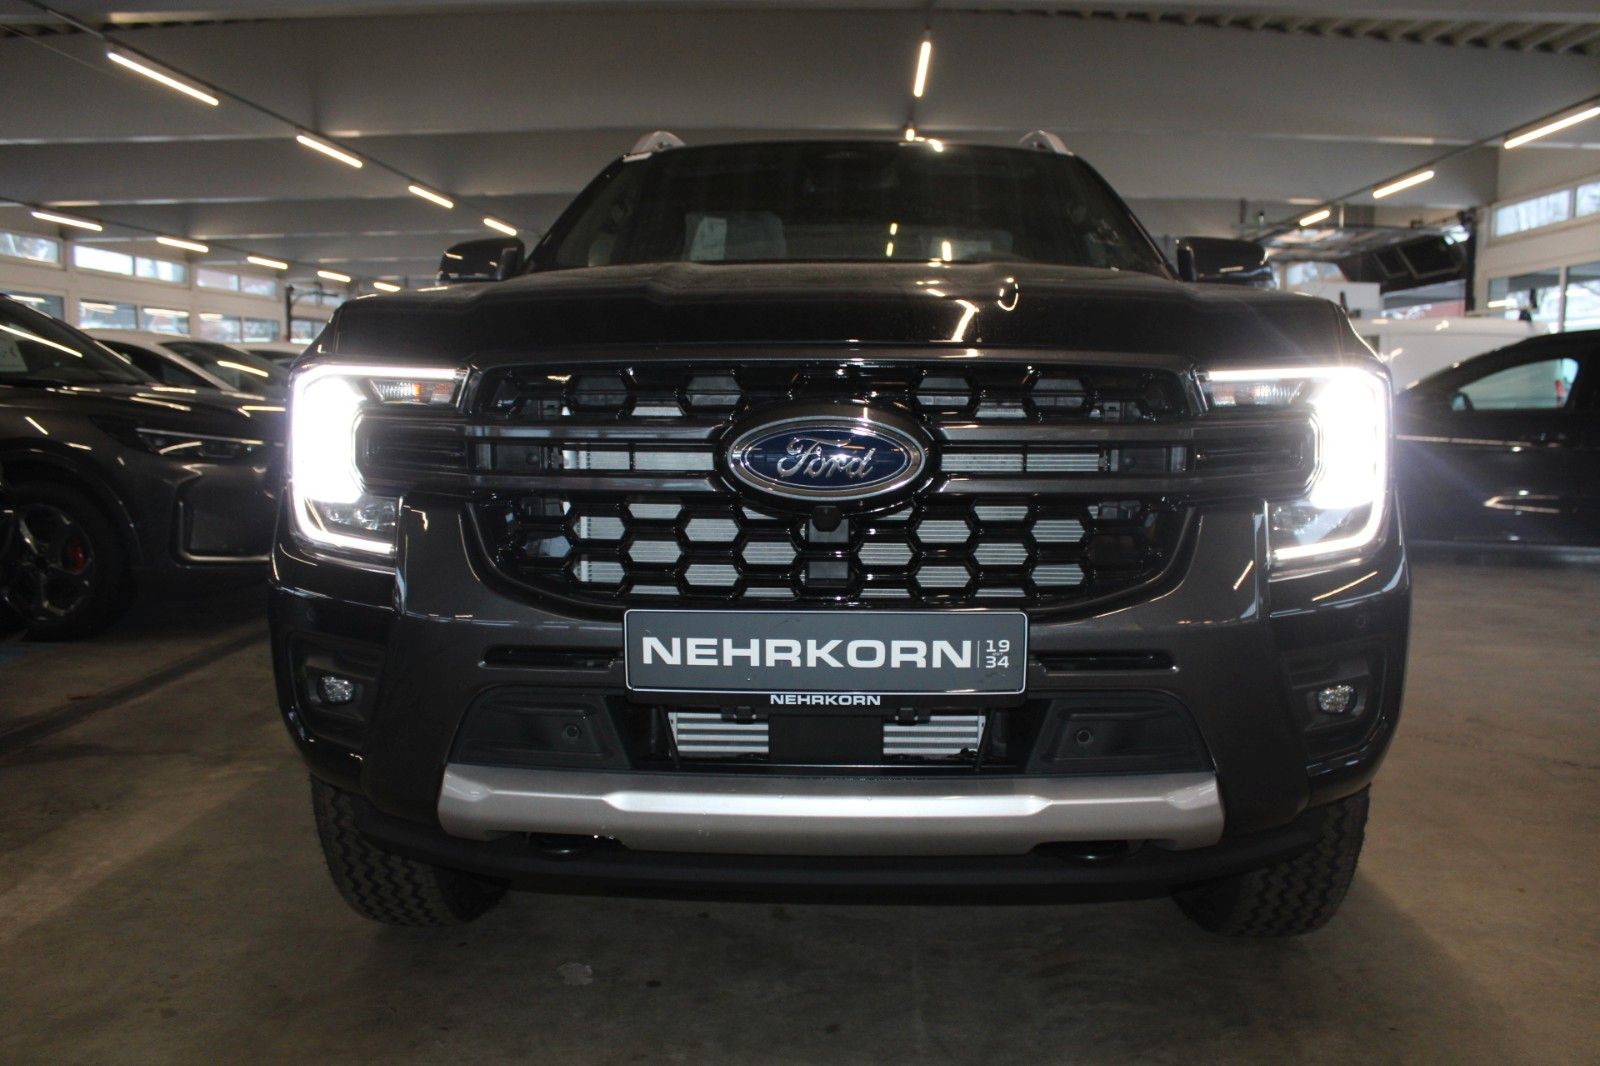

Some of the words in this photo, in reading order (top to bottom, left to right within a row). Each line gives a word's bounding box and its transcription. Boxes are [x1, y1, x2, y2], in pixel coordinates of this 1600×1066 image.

[776, 437, 876, 478] Ford
[641, 636, 973, 669] NEHRKORN
[986, 640, 1010, 652] 19
[985, 655, 1009, 668] 34
[769, 694, 882, 706] NEHRKORN
